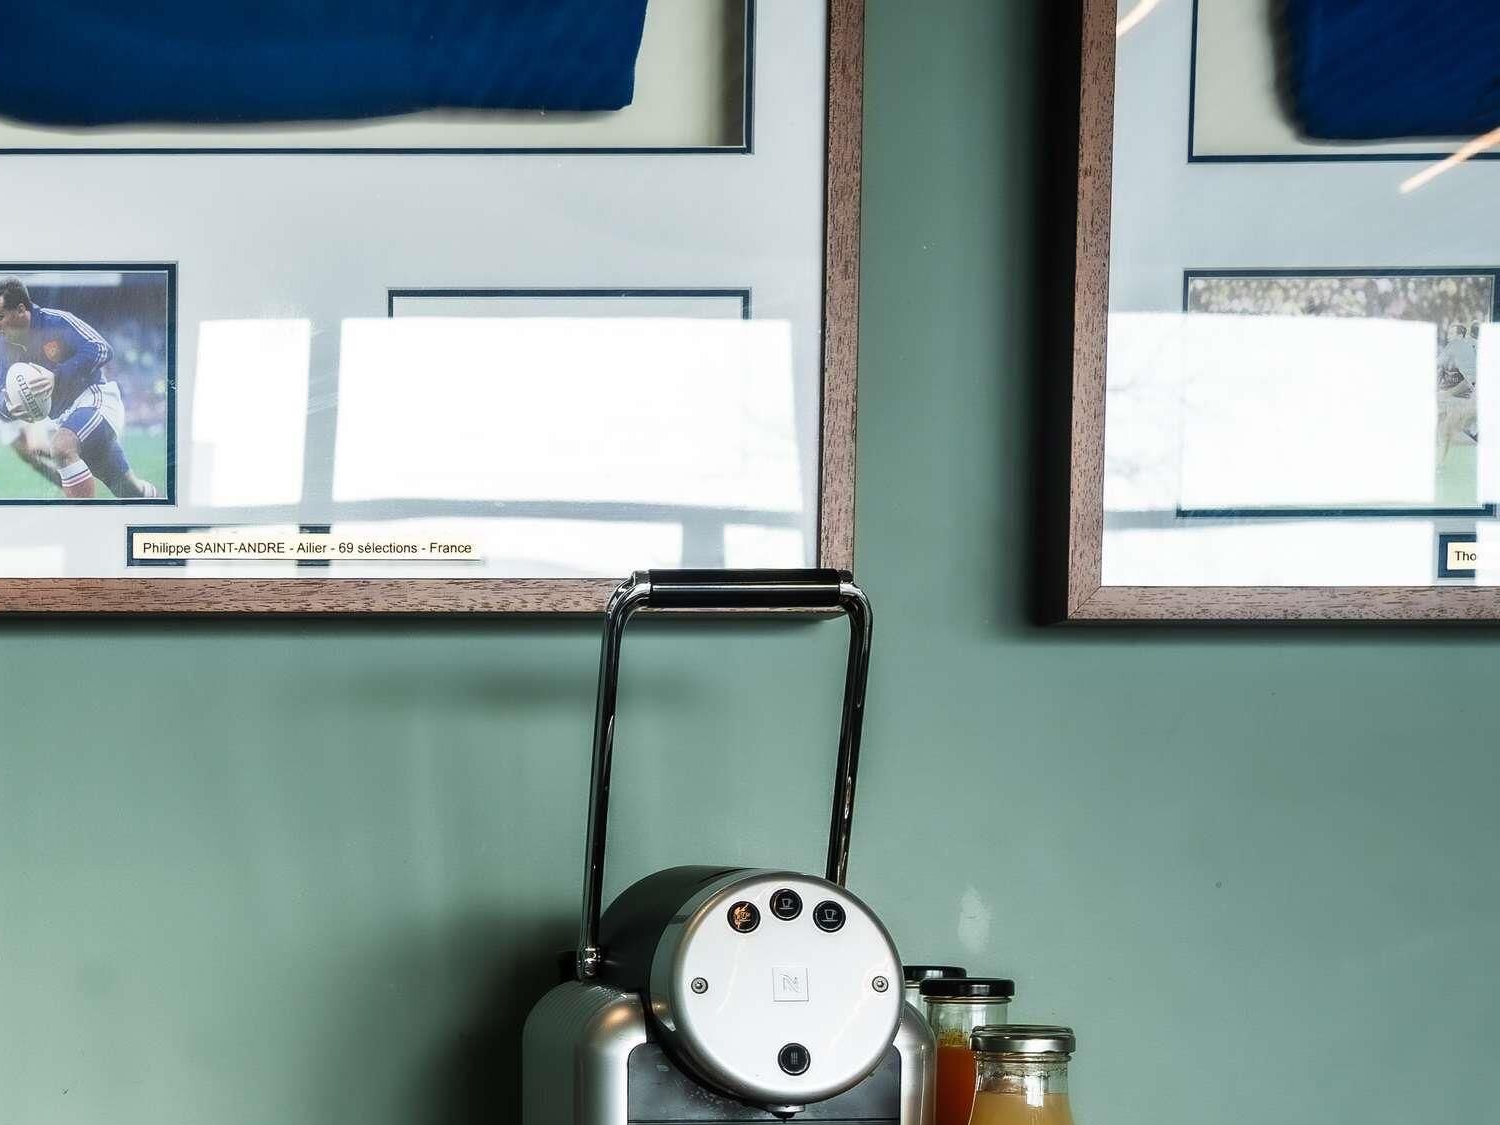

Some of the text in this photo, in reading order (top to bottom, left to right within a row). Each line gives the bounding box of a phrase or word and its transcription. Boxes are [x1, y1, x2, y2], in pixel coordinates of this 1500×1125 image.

[143, 541, 191, 556] Philippe
[195, 541, 286, 554] SAINT-ANDRE
[297, 541, 327, 554] Ailier
[338, 541, 355, 554] 69
[357, 541, 418, 554] sélections
[430, 541, 473, 554] France
